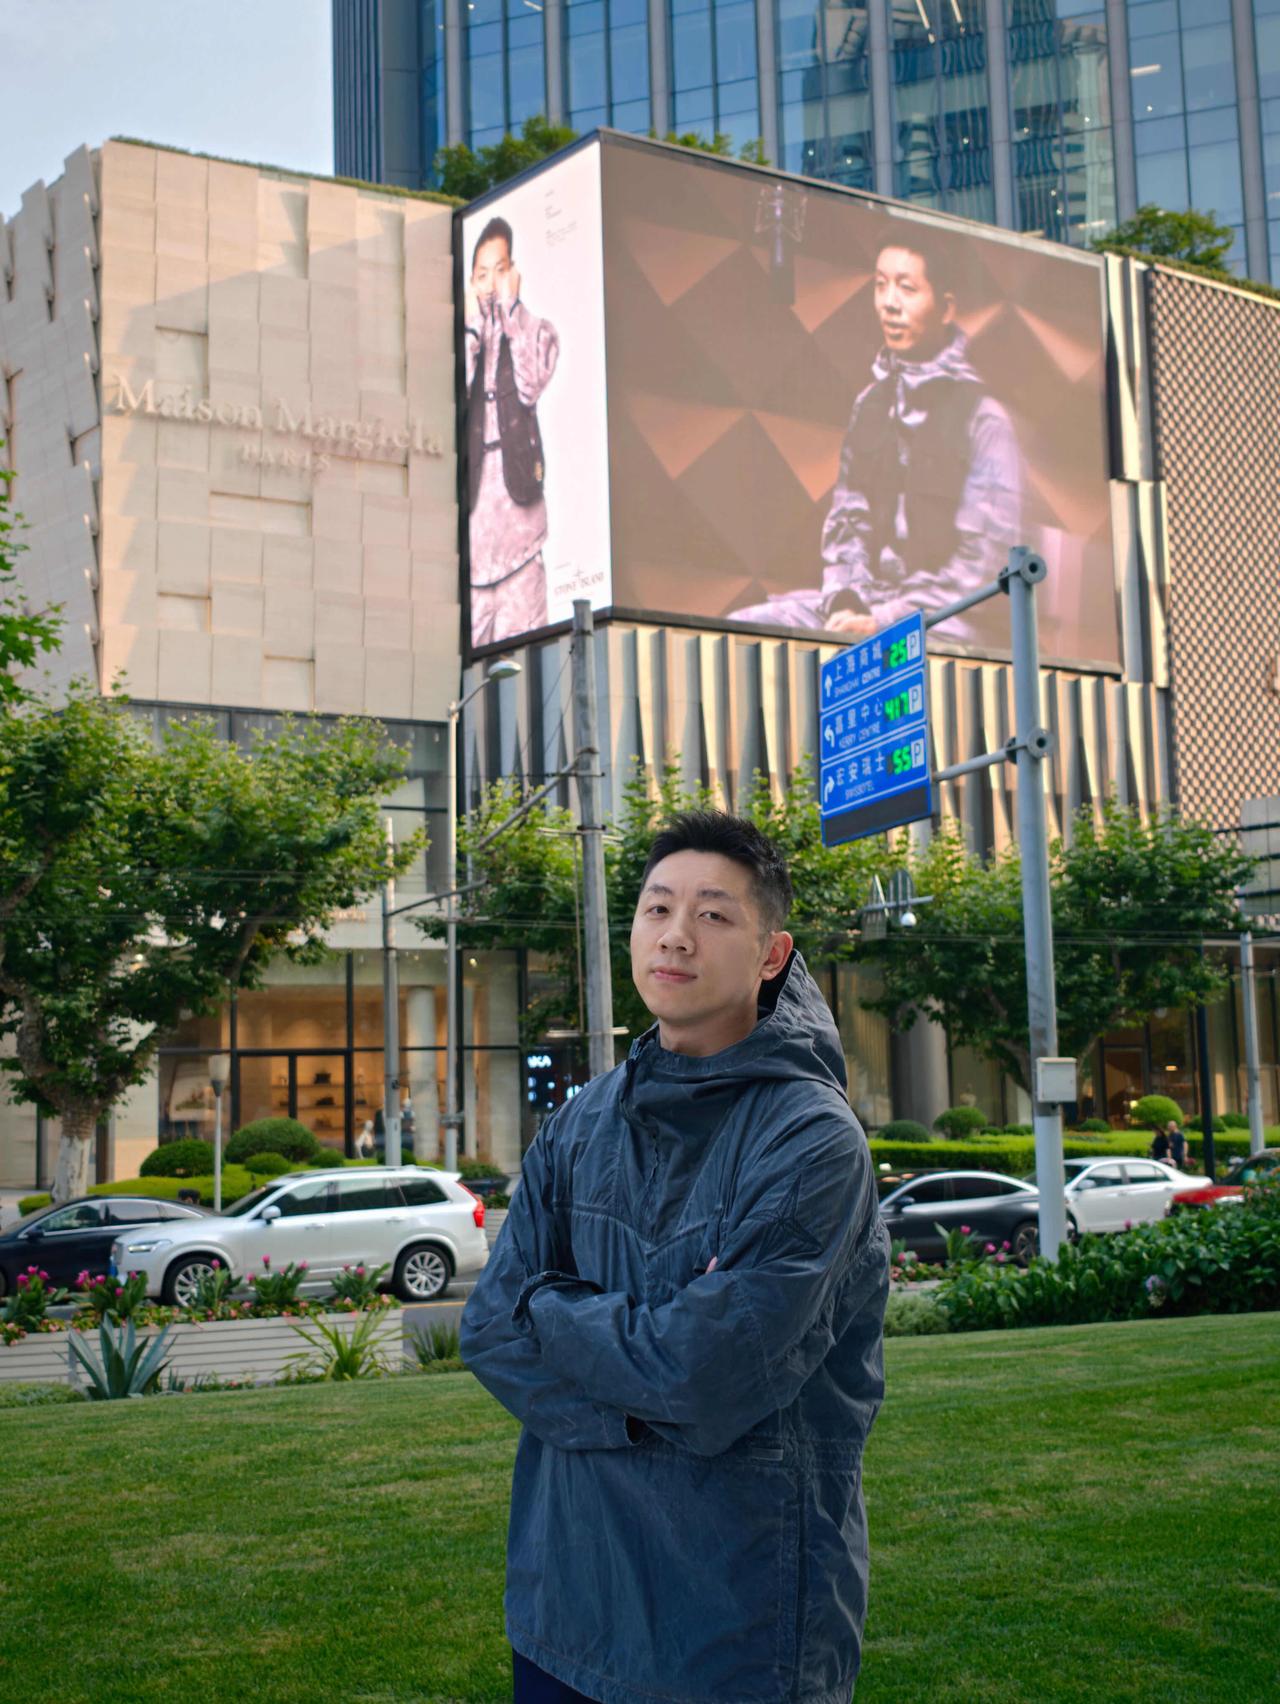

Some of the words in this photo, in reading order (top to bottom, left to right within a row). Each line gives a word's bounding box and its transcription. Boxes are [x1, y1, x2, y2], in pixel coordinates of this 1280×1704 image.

[115, 375, 263, 428] Maison
[276, 397, 443, 455] Margiela
[240, 444, 331, 470] PARIS
[889, 638, 908, 668] 25
[893, 745, 912, 774] 55
